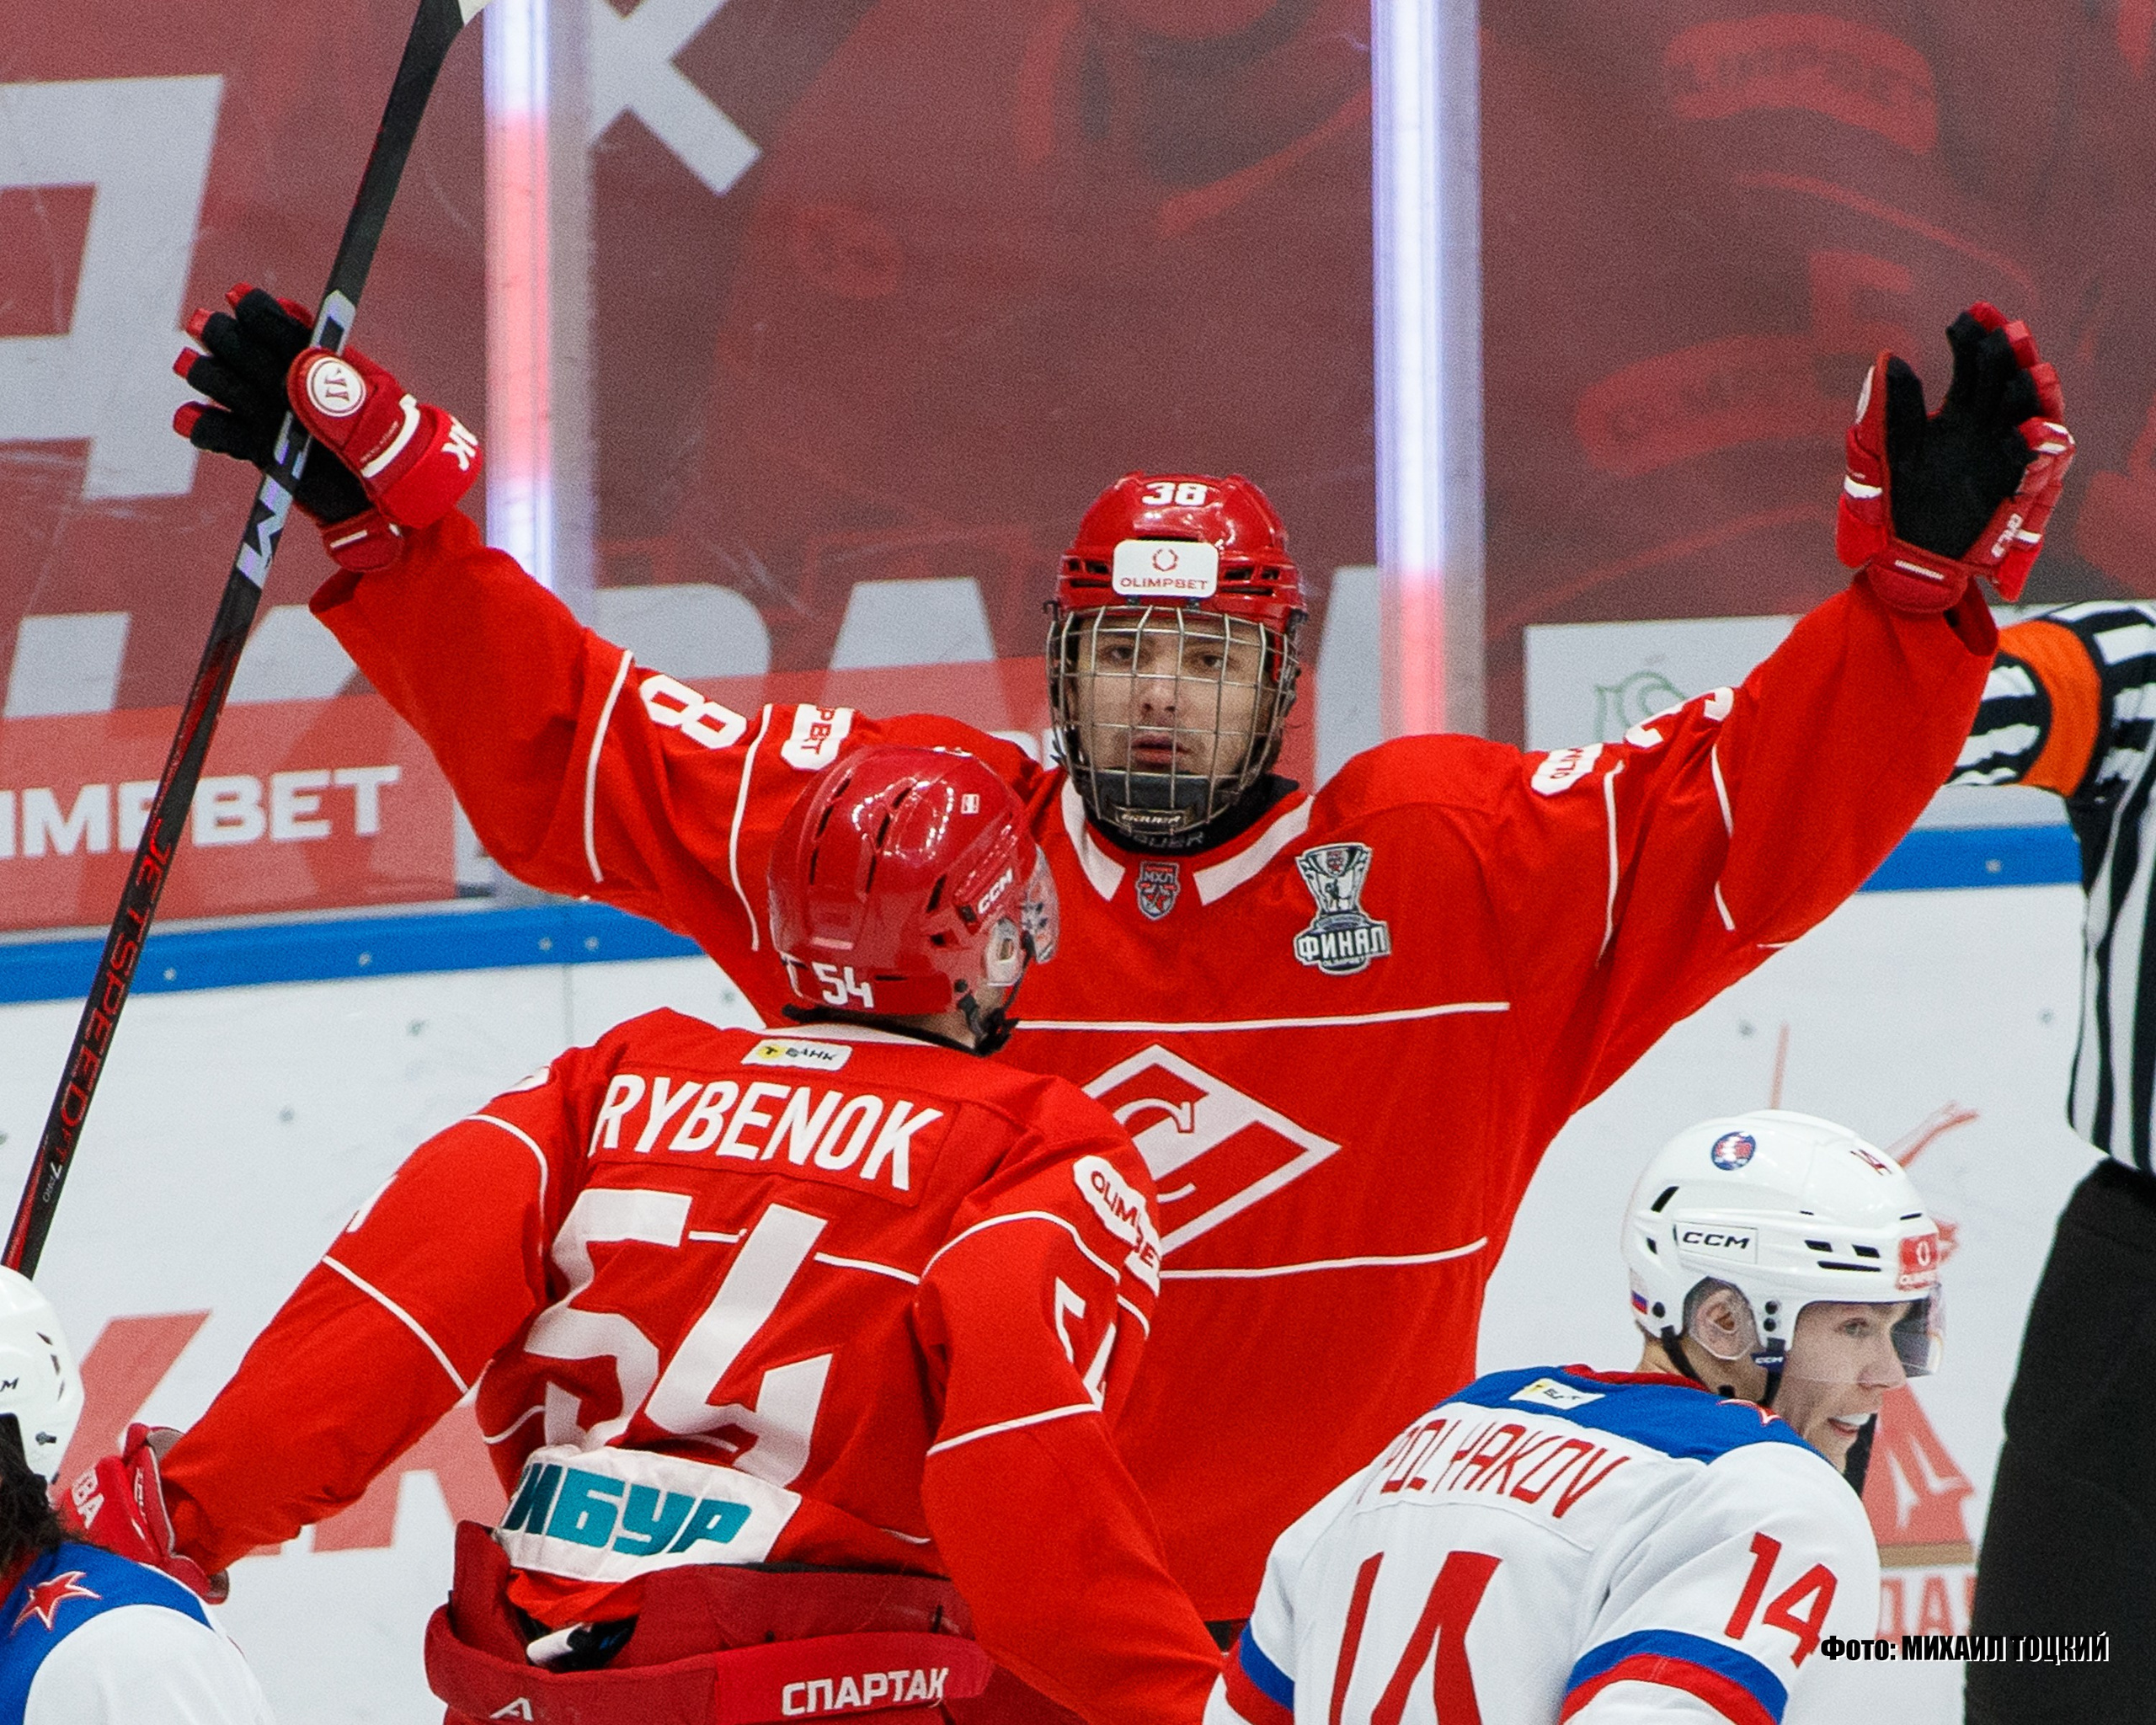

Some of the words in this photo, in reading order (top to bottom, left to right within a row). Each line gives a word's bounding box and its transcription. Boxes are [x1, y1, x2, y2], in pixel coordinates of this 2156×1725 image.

[1142, 482, 1208, 505] 38
[1120, 577, 1209, 590] OLIMPBET
[1298, 927, 1387, 960] ФИНАЛ
[811, 961, 874, 1009] 54
[588, 1074, 944, 1191] RYBENOK
[1682, 1231, 1751, 1250] CCM
[523, 1188, 834, 1488] 54
[1356, 1418, 1632, 1519] POLYAKOV
[503, 1462, 753, 1557] ИБУР
[1724, 1531, 1838, 1669] 14
[782, 1667, 949, 1717] СПАРТАК
